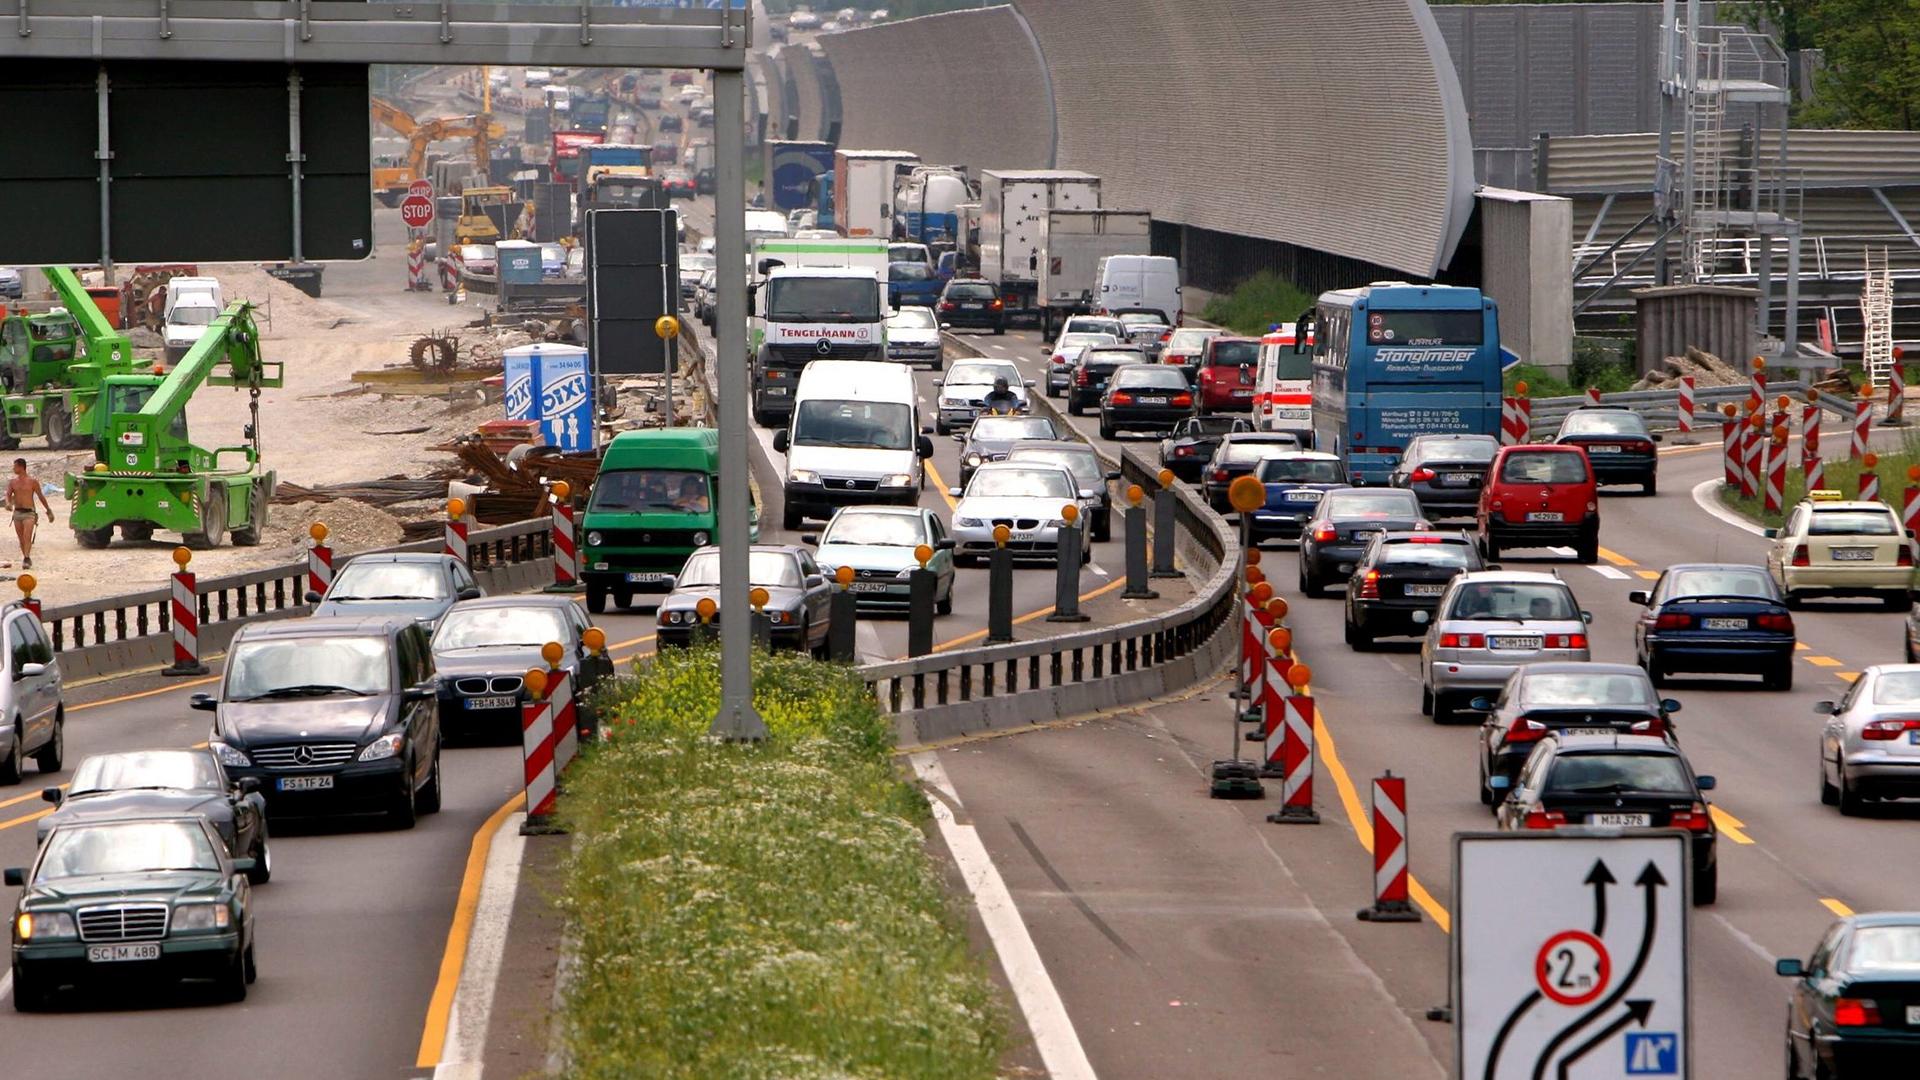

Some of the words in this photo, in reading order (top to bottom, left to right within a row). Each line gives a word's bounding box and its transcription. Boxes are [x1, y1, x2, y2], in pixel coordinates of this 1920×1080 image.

[403, 204, 431, 219] STOP
[780, 328, 856, 338] TENGELMANN
[128, 455, 136, 464] 20
[1518, 638, 1539, 649] 1119
[283, 778, 297, 790] FS
[304, 777, 317, 788] TF
[319, 777, 331, 788] 24
[1601, 815, 1609, 825] M
[1623, 815, 1643, 825] 378
[92, 947, 111, 961] SC
[118, 947, 129, 960] M
[133, 945, 157, 958] 488
